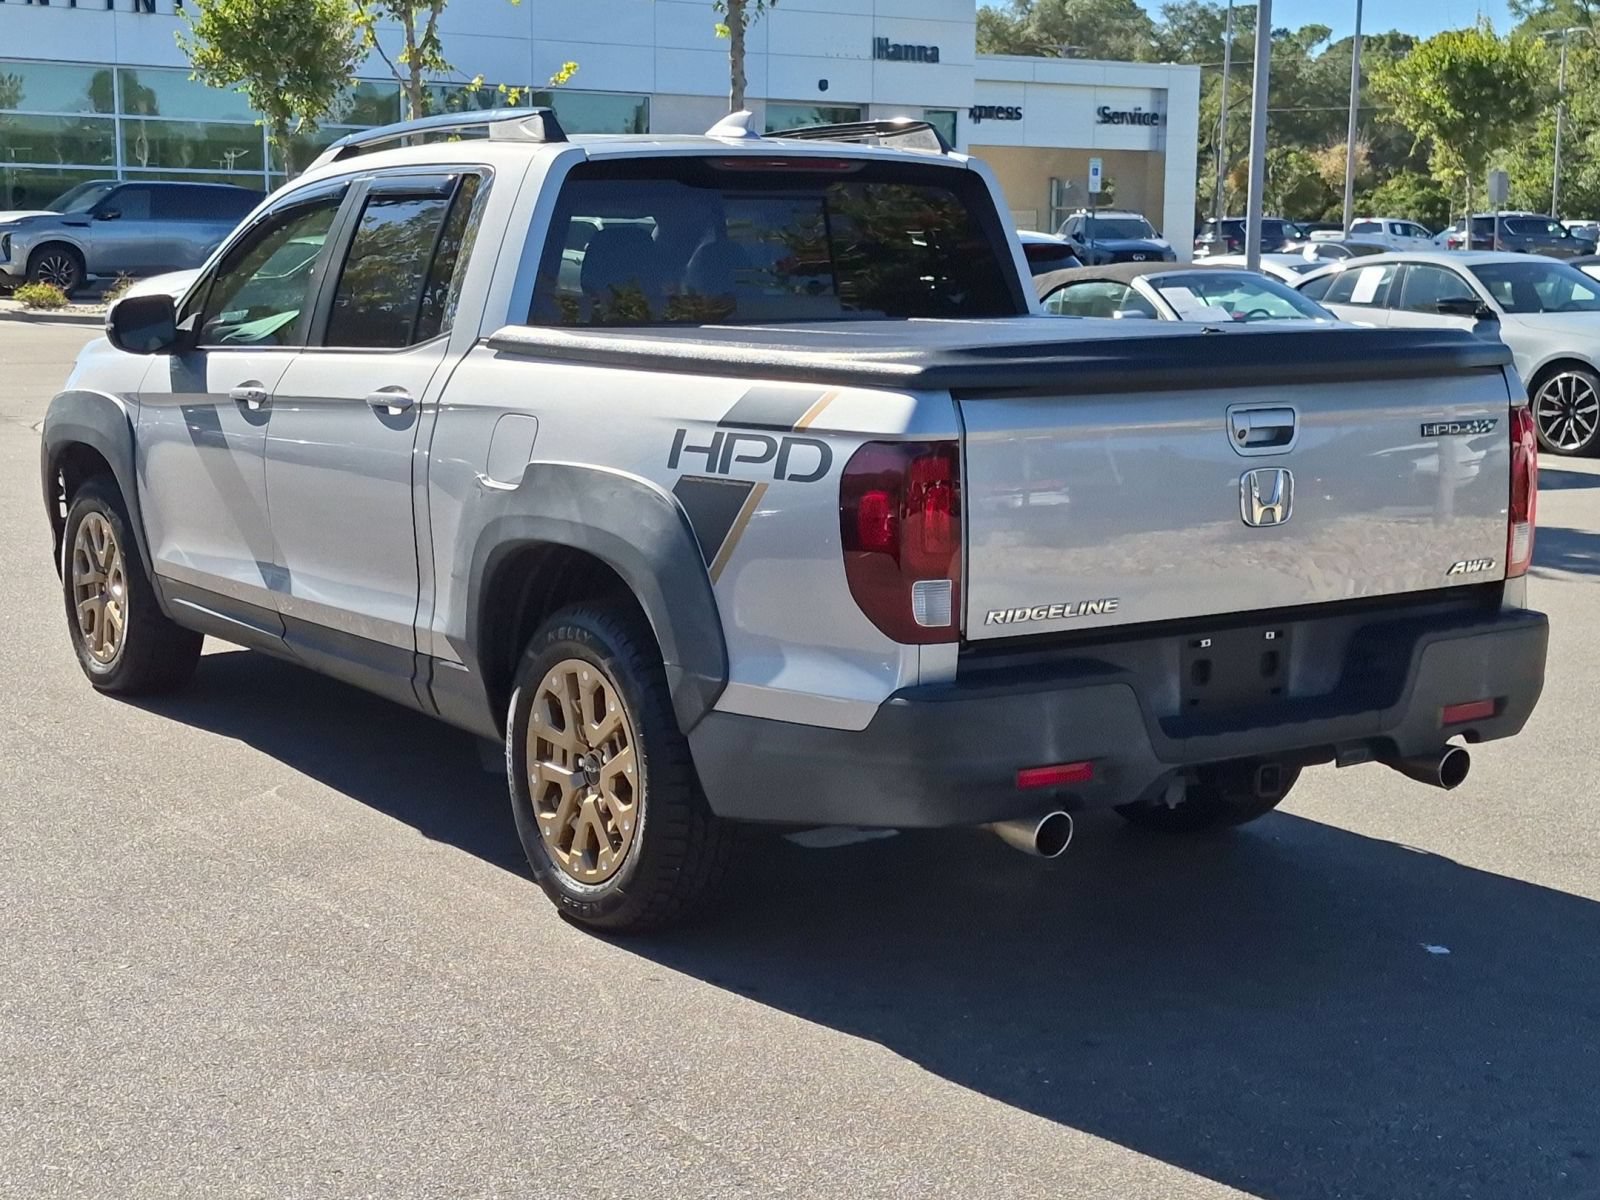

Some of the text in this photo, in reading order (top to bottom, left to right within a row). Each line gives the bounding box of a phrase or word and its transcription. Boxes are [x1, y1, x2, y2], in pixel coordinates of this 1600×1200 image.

[874, 36, 939, 63] Hanna
[1096, 105, 1160, 126] Service
[1423, 423, 1461, 436] HPD
[667, 428, 833, 483] HPD
[1446, 558, 1496, 575] AWD
[984, 597, 1119, 626] RIDGELINE
